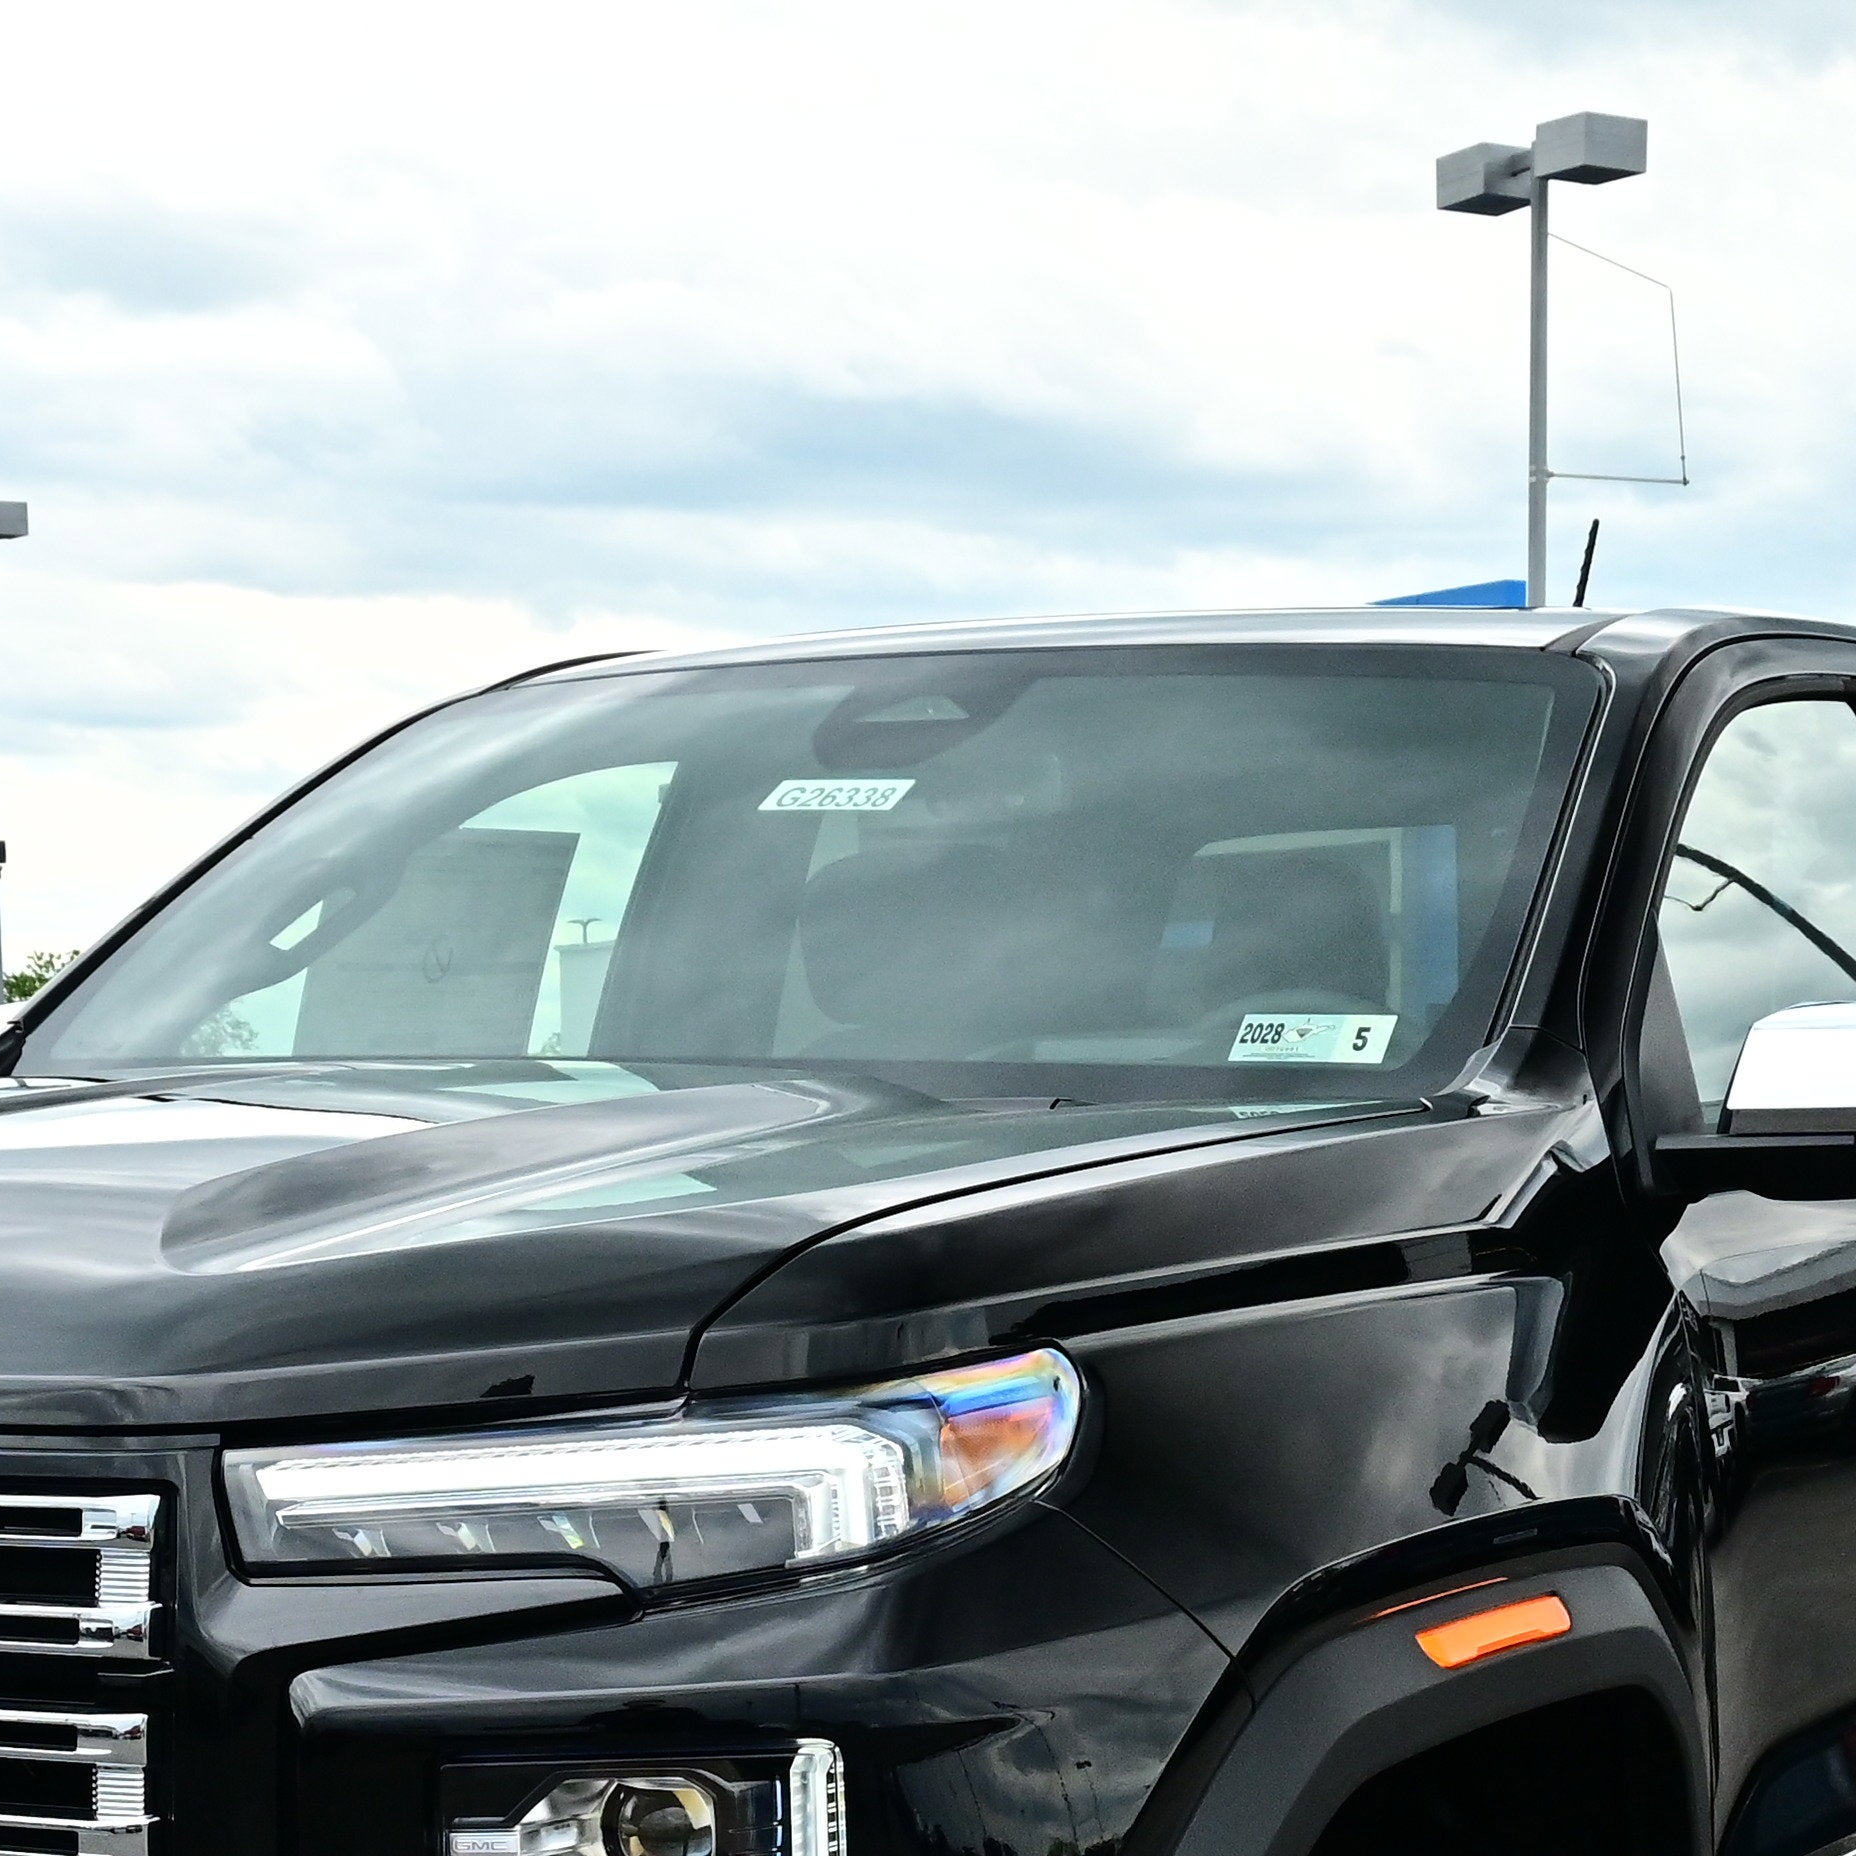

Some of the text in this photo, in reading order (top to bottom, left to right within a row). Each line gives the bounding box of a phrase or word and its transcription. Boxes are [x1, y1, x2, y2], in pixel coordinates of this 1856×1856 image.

[776, 786, 898, 808] G26338
[1239, 1022, 1286, 1044] 2028
[1352, 1026, 1372, 1052] 5
[454, 1840, 508, 1851] GMC
